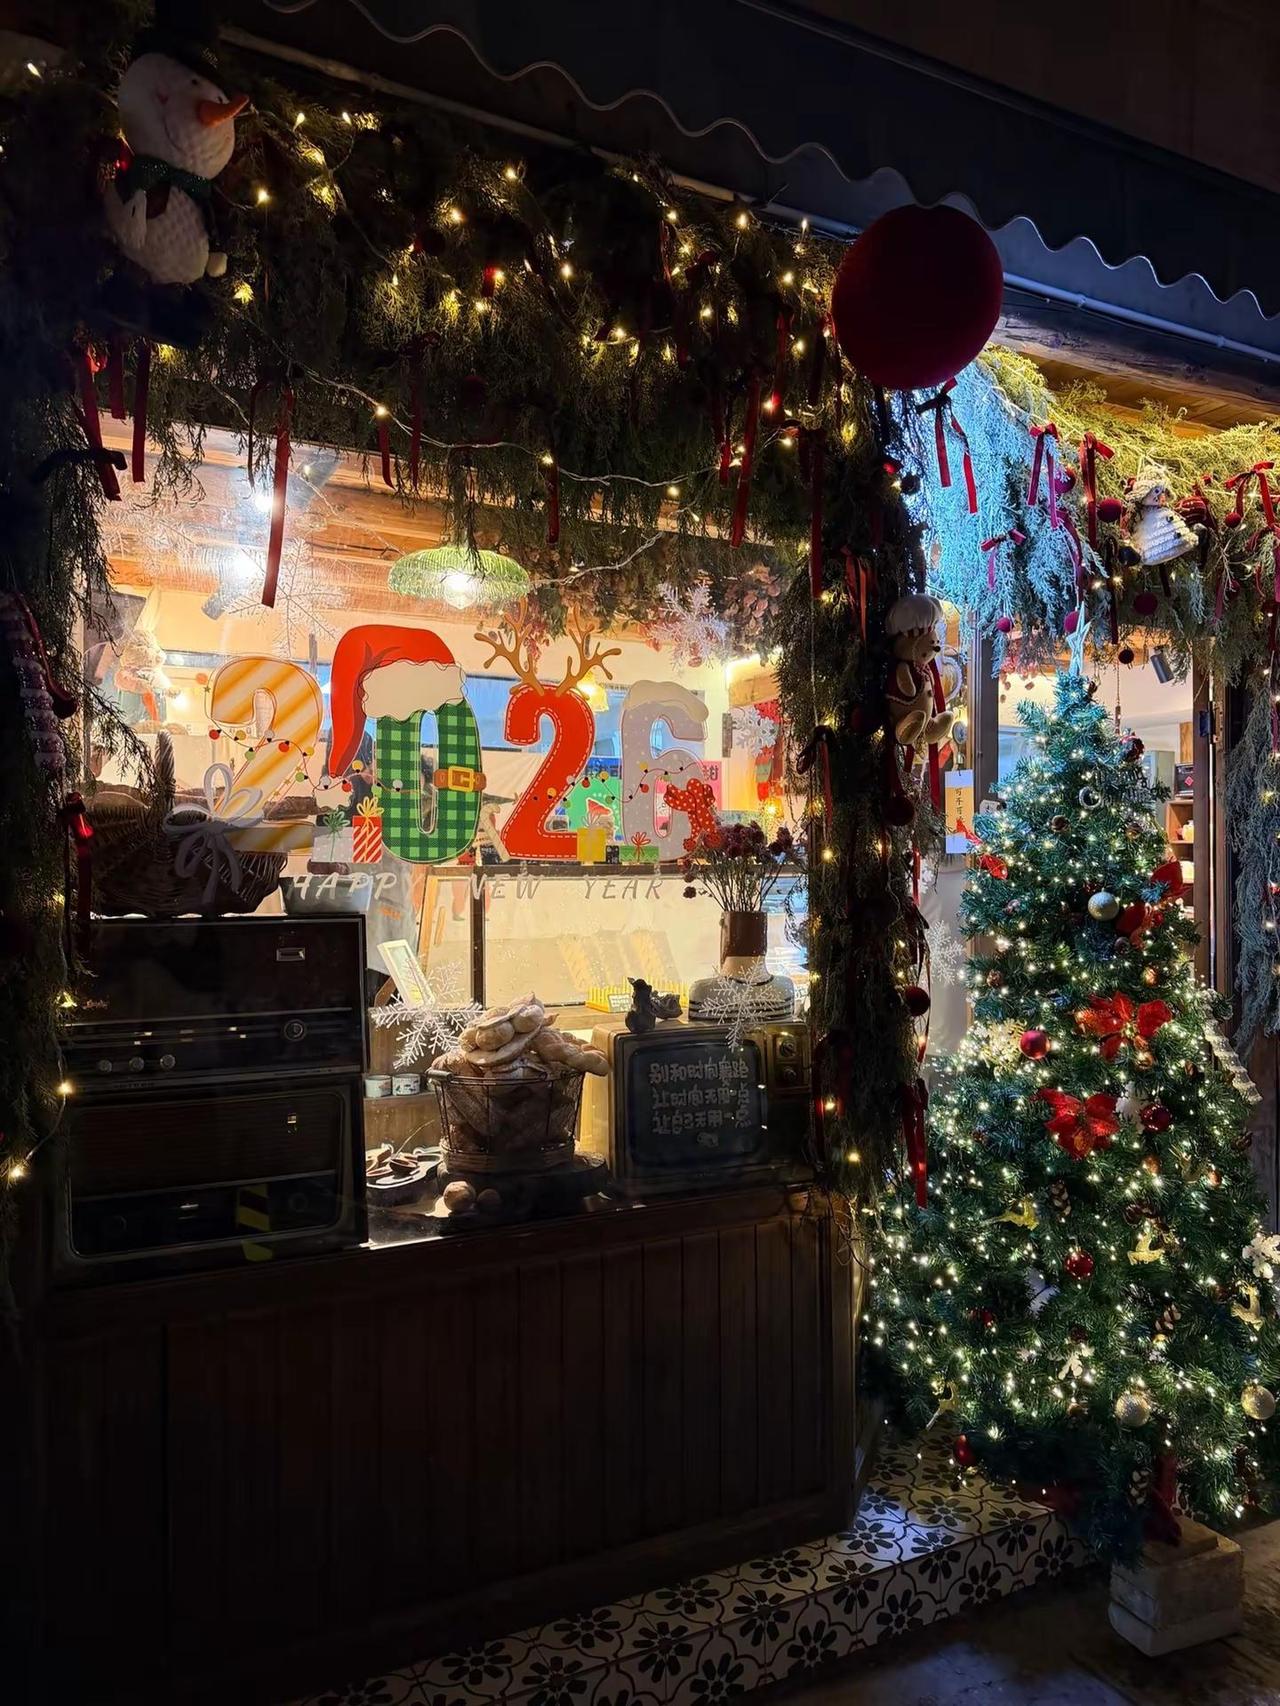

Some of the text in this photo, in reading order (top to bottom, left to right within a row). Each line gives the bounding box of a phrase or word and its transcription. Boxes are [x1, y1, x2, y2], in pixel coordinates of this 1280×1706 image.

[208, 638, 712, 864] 2026
[471, 873, 545, 900] NEW
[583, 873, 663, 900] YEAR
